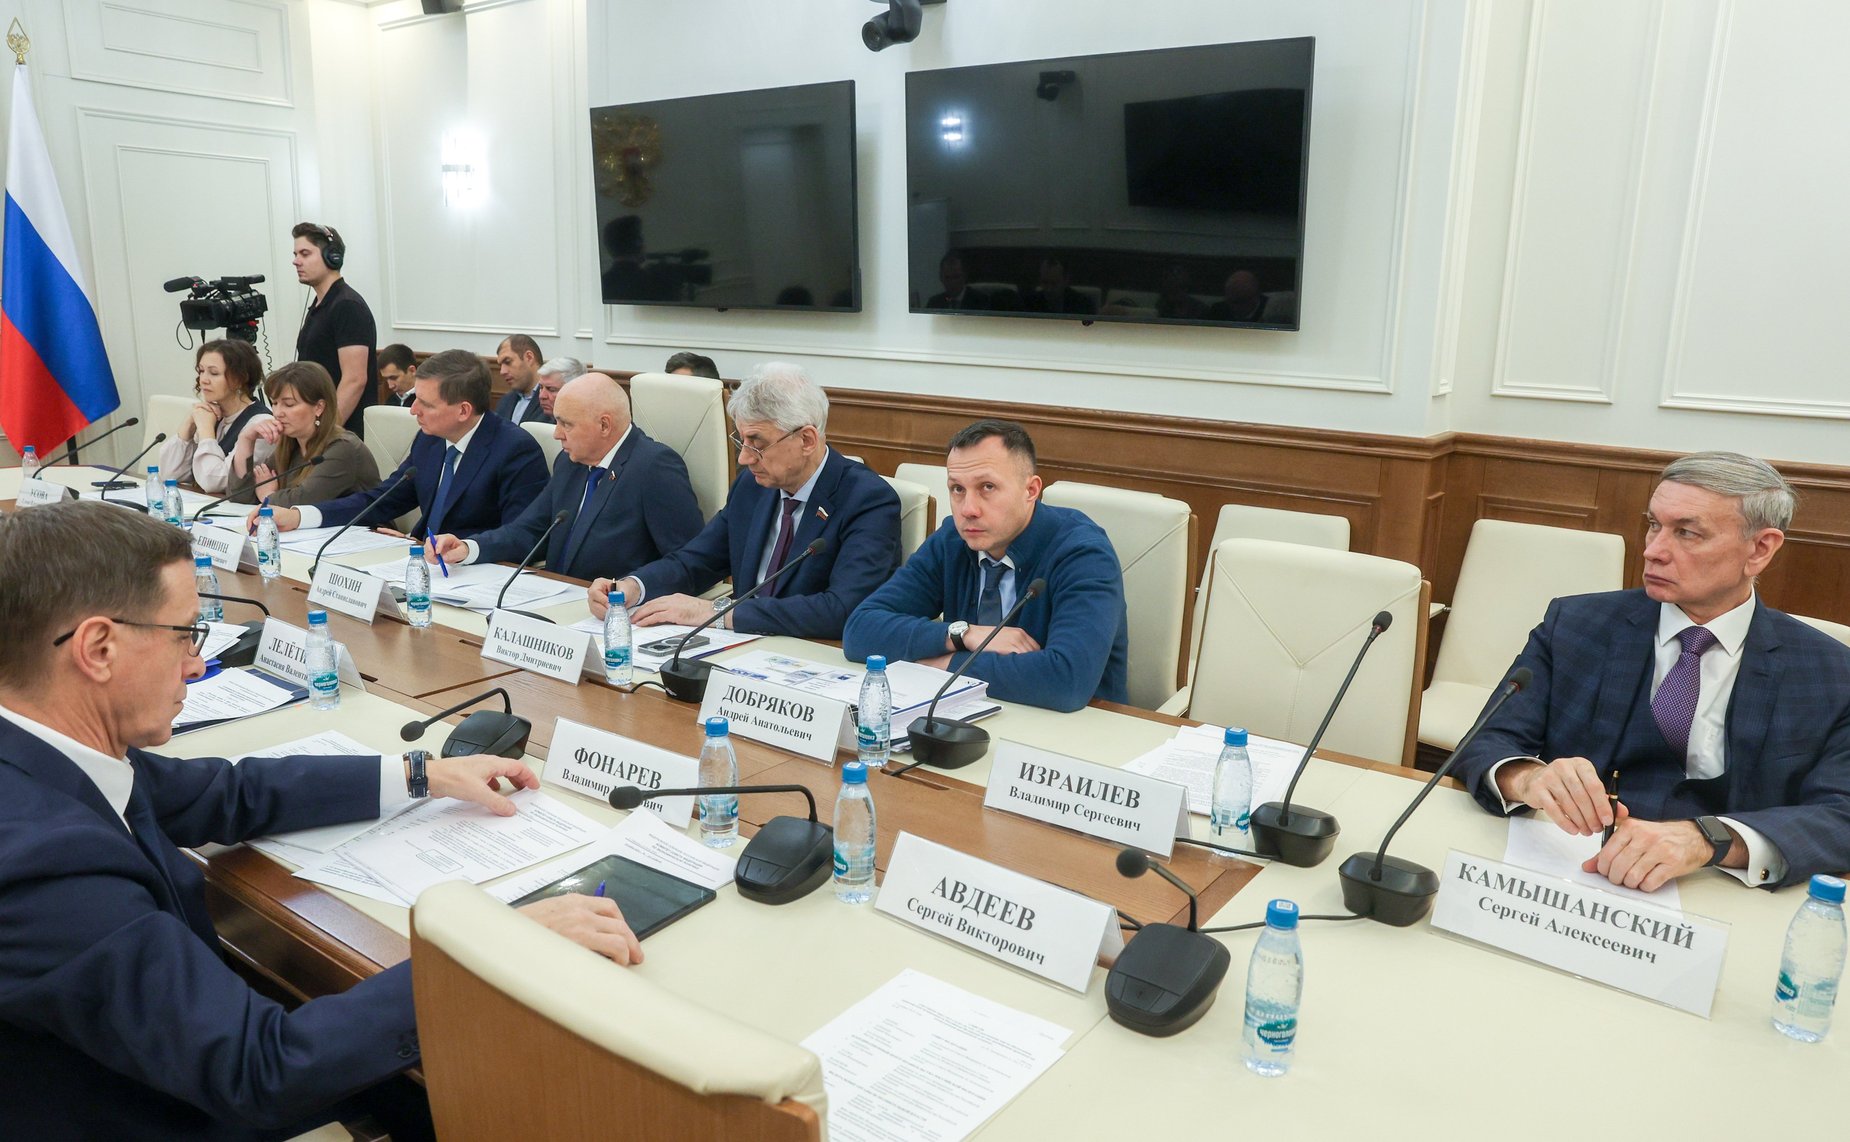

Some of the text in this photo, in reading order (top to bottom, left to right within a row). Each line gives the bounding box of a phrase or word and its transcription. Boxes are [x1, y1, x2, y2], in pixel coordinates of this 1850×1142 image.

[316, 585, 332, 597] Андрей
[328, 572, 362, 593] ШОХИН
[268, 637, 306, 664] ЛЕЛЁТИ
[493, 626, 574, 660] КАЛАШНИКОВ
[496, 645, 562, 673] Виктор Дмитриевич
[259, 653, 309, 681] Анастасия Валенти
[722, 684, 815, 723] ДОБРЯКОВ
[716, 705, 812, 742] Андрей Анатольевич
[562, 768, 610, 796] Владимир
[574, 746, 662, 790] ФОНАРЕВ
[1018, 761, 1141, 809] ИЗРАИЛЕВ
[1009, 785, 1141, 832] Владимир Сергеевич
[931, 876, 1036, 932] АВДЕЕВ
[1458, 862, 1697, 950] КАМЫШАНСКИЙ
[907, 897, 1045, 966] Сергей Викторович
[1478, 896, 1657, 964] Сергей Алексеевич
